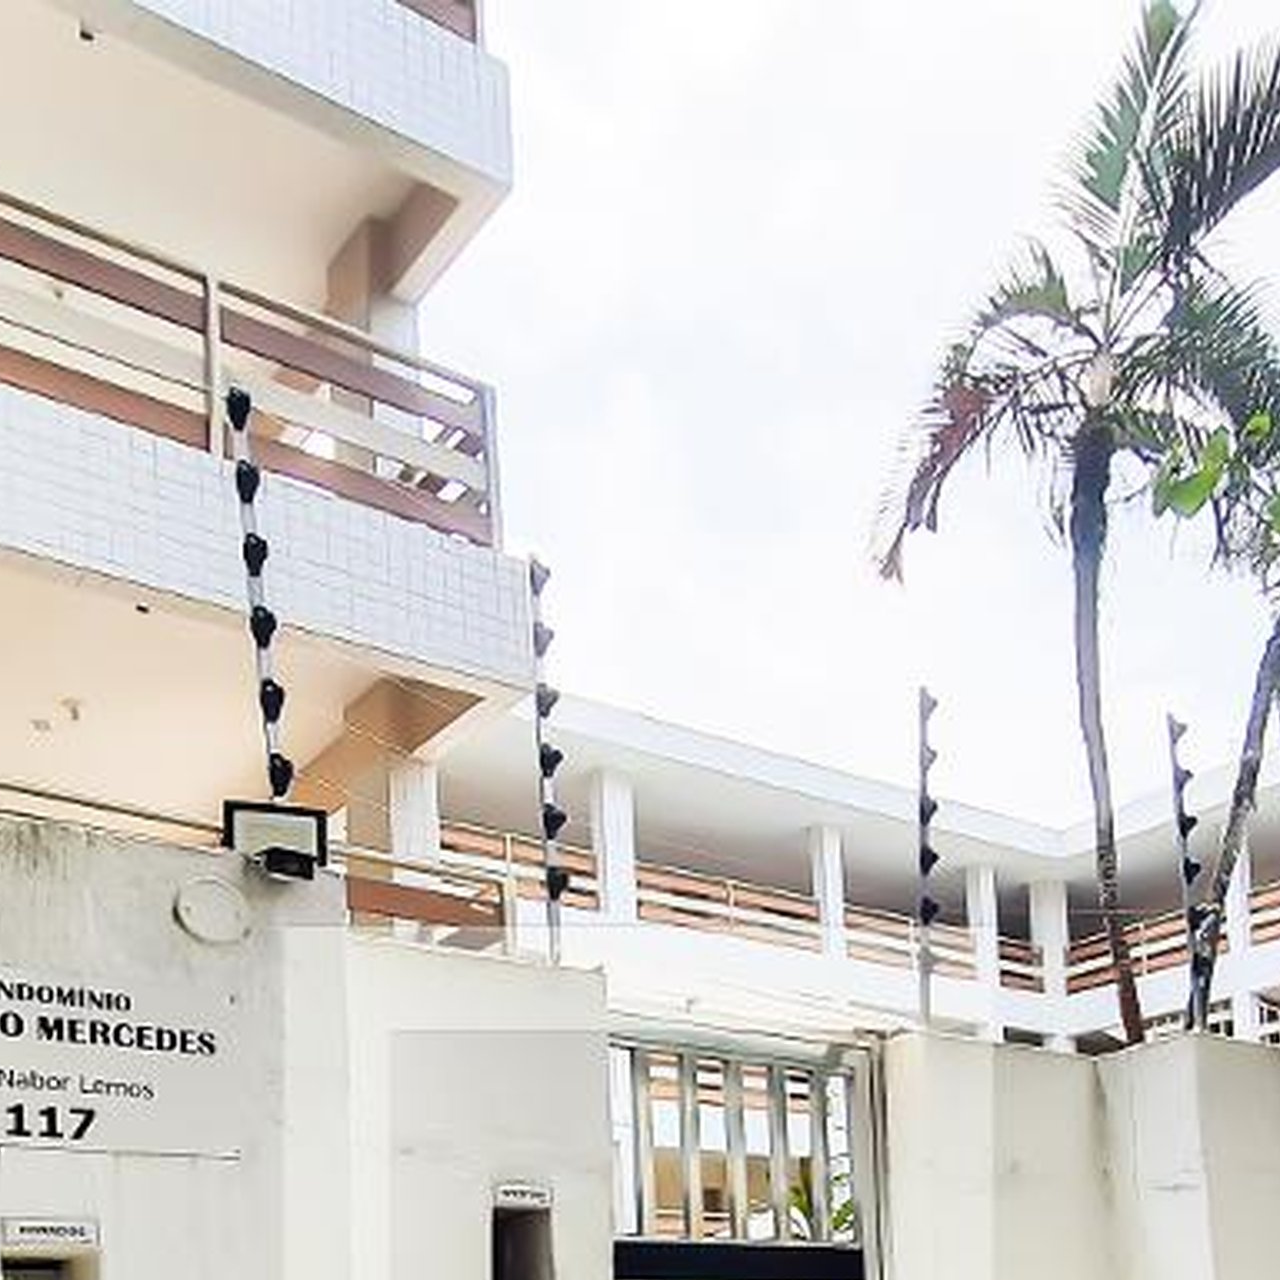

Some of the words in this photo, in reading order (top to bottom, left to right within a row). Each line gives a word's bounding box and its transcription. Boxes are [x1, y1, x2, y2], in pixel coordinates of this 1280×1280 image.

[36, 1015, 216, 1056] MERCEDES
[79, 1073, 155, 1100] Lemos
[5, 1102, 96, 1141] 117
